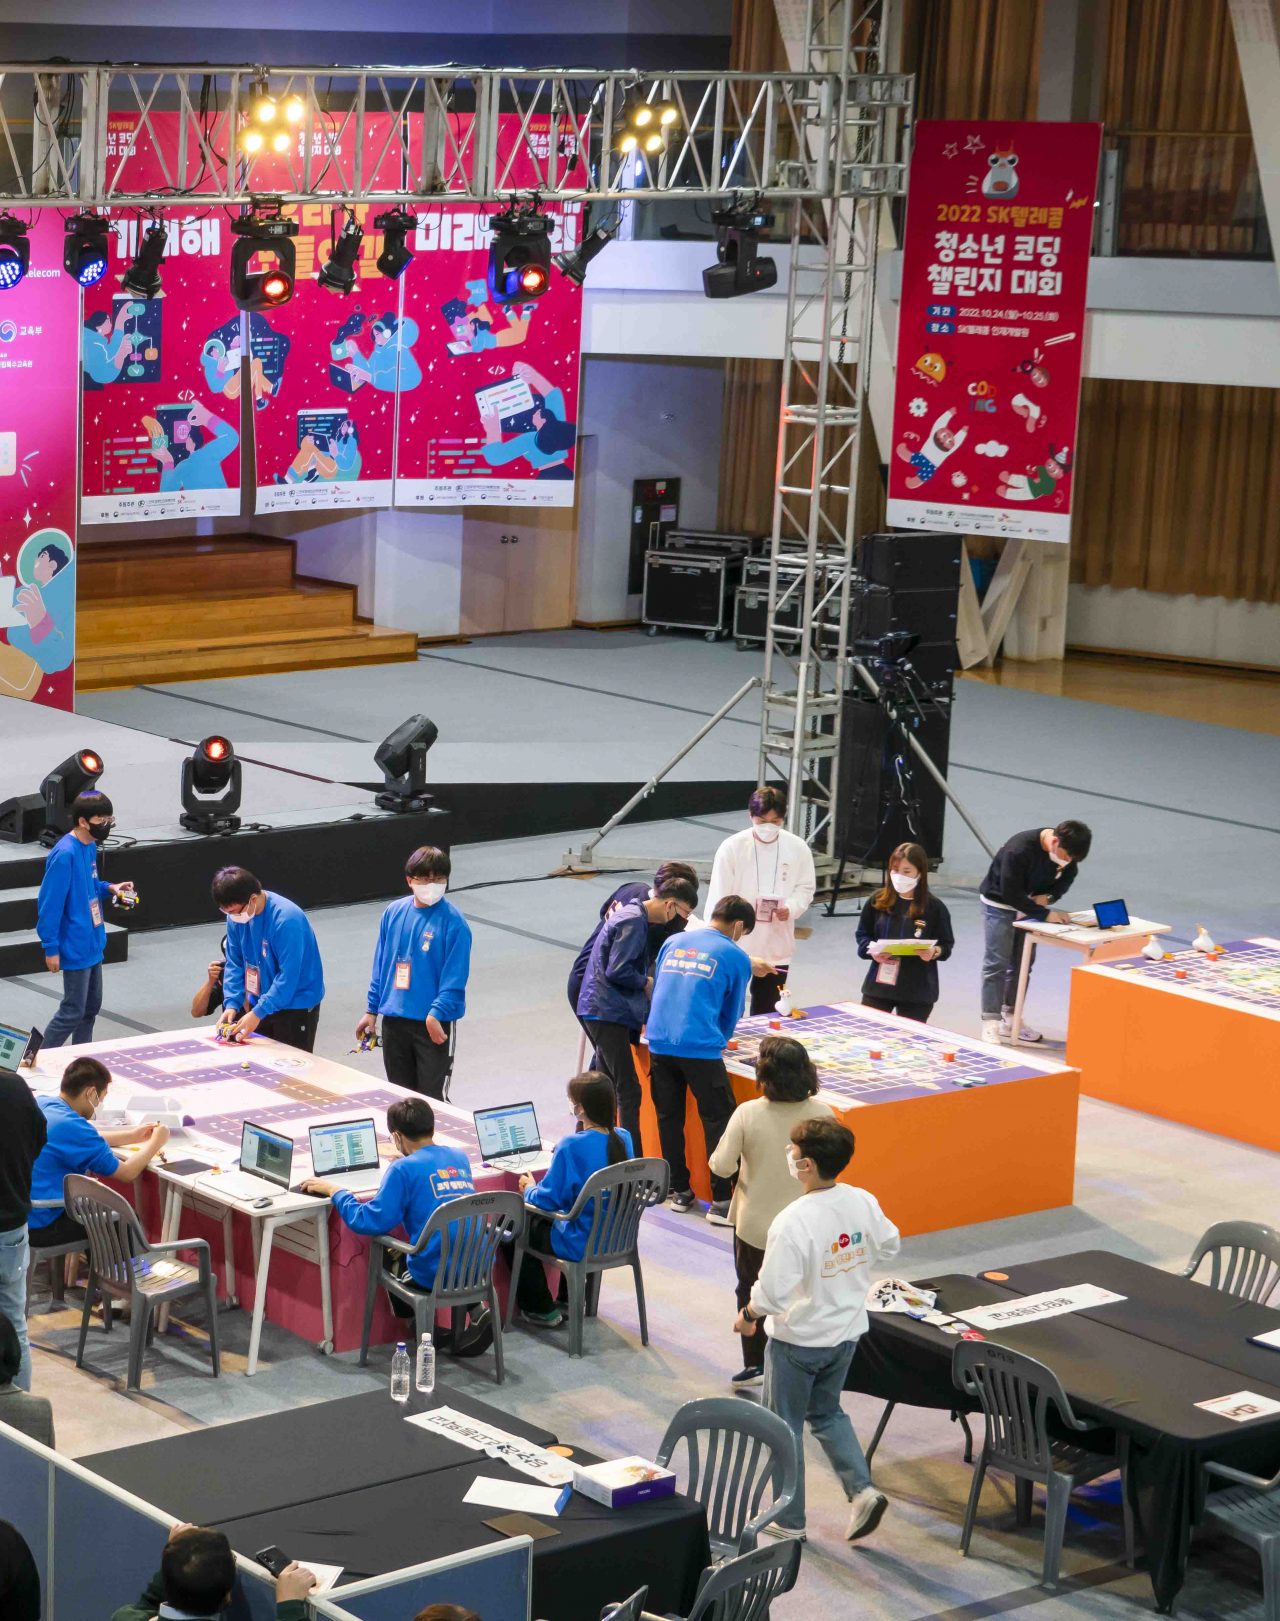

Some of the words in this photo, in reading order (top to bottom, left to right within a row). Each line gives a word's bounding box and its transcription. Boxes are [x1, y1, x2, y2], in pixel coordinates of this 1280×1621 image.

[937, 204, 982, 223] 2022
[987, 206, 1064, 229] SK텔레콤
[934, 230, 1006, 264] 청소년
[1013, 236, 1061, 268] 코딩
[927, 263, 1002, 297] 챌린지
[1011, 268, 1063, 296] 대회
[19, 326, 43, 336] 교육부
[471, 1197, 496, 1206] FOCUS
